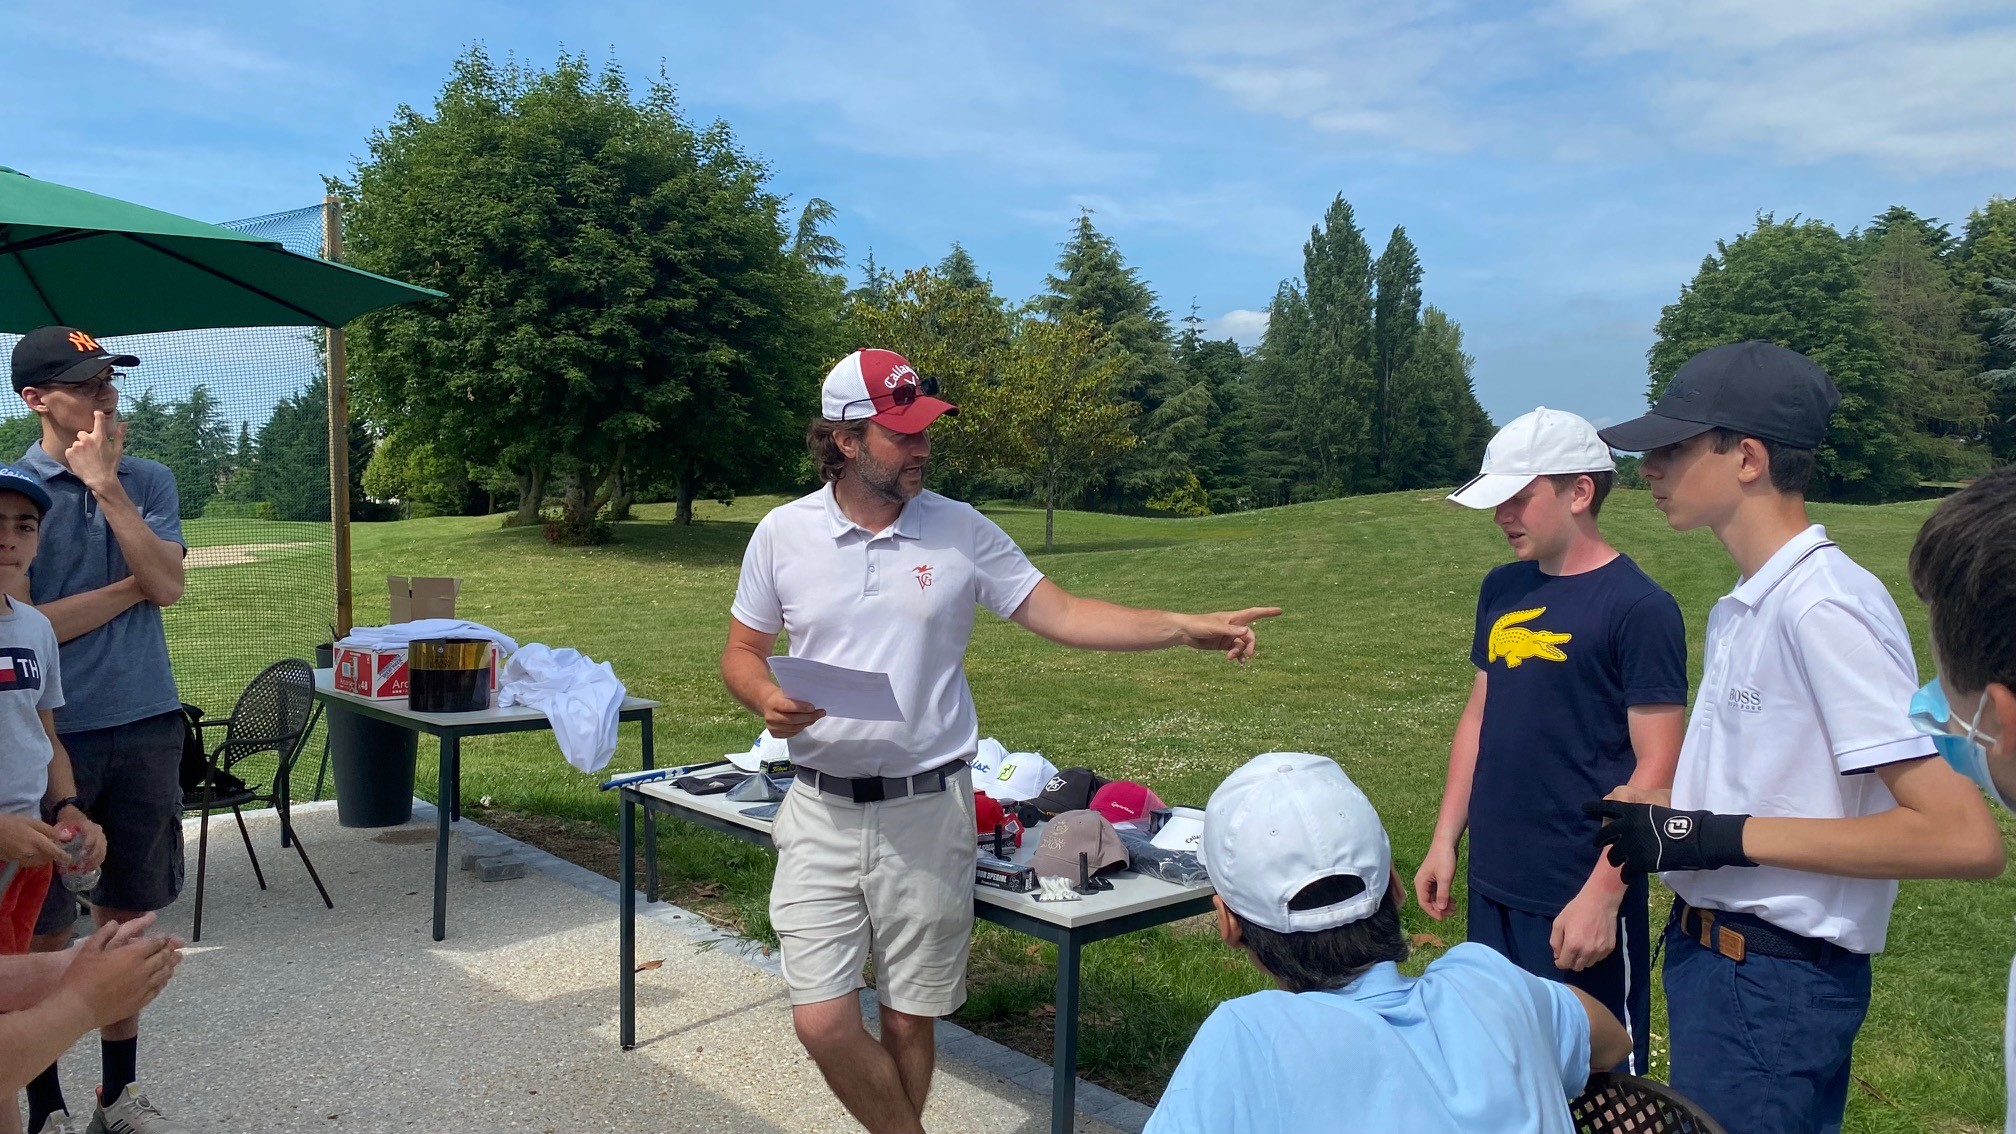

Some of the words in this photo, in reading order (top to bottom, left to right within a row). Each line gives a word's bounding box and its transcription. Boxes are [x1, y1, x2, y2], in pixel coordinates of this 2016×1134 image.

[69, 331, 99, 352] NY
[17, 659, 39, 679] TH
[1729, 688, 1761, 706] BOSS
